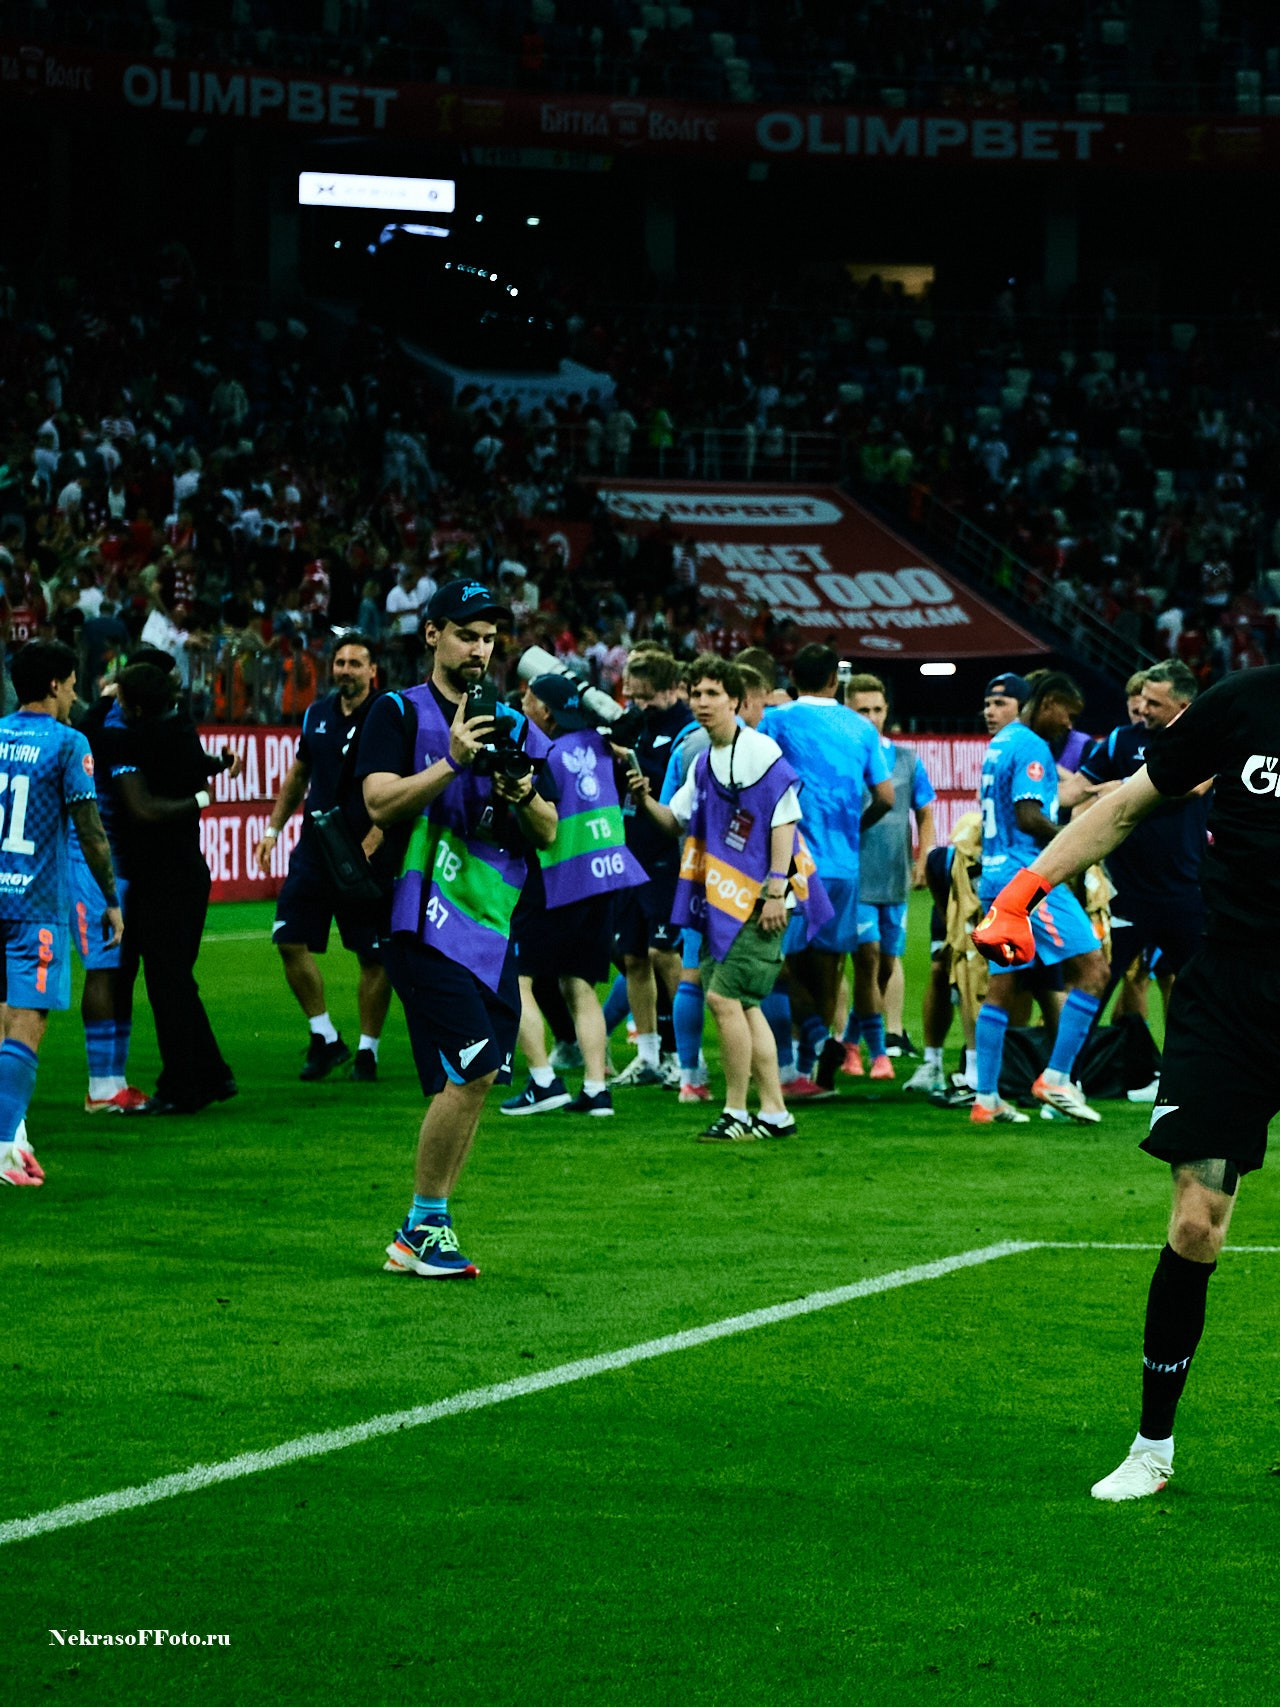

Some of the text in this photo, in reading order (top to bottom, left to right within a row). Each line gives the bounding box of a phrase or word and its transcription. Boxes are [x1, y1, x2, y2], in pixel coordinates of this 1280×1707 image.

[122, 63, 399, 129] OLIMPBET
[754, 111, 1105, 160] OLIMPBET
[813, 567, 954, 609] 000
[590, 852, 625, 878] 016
[706, 868, 754, 910] РФС
